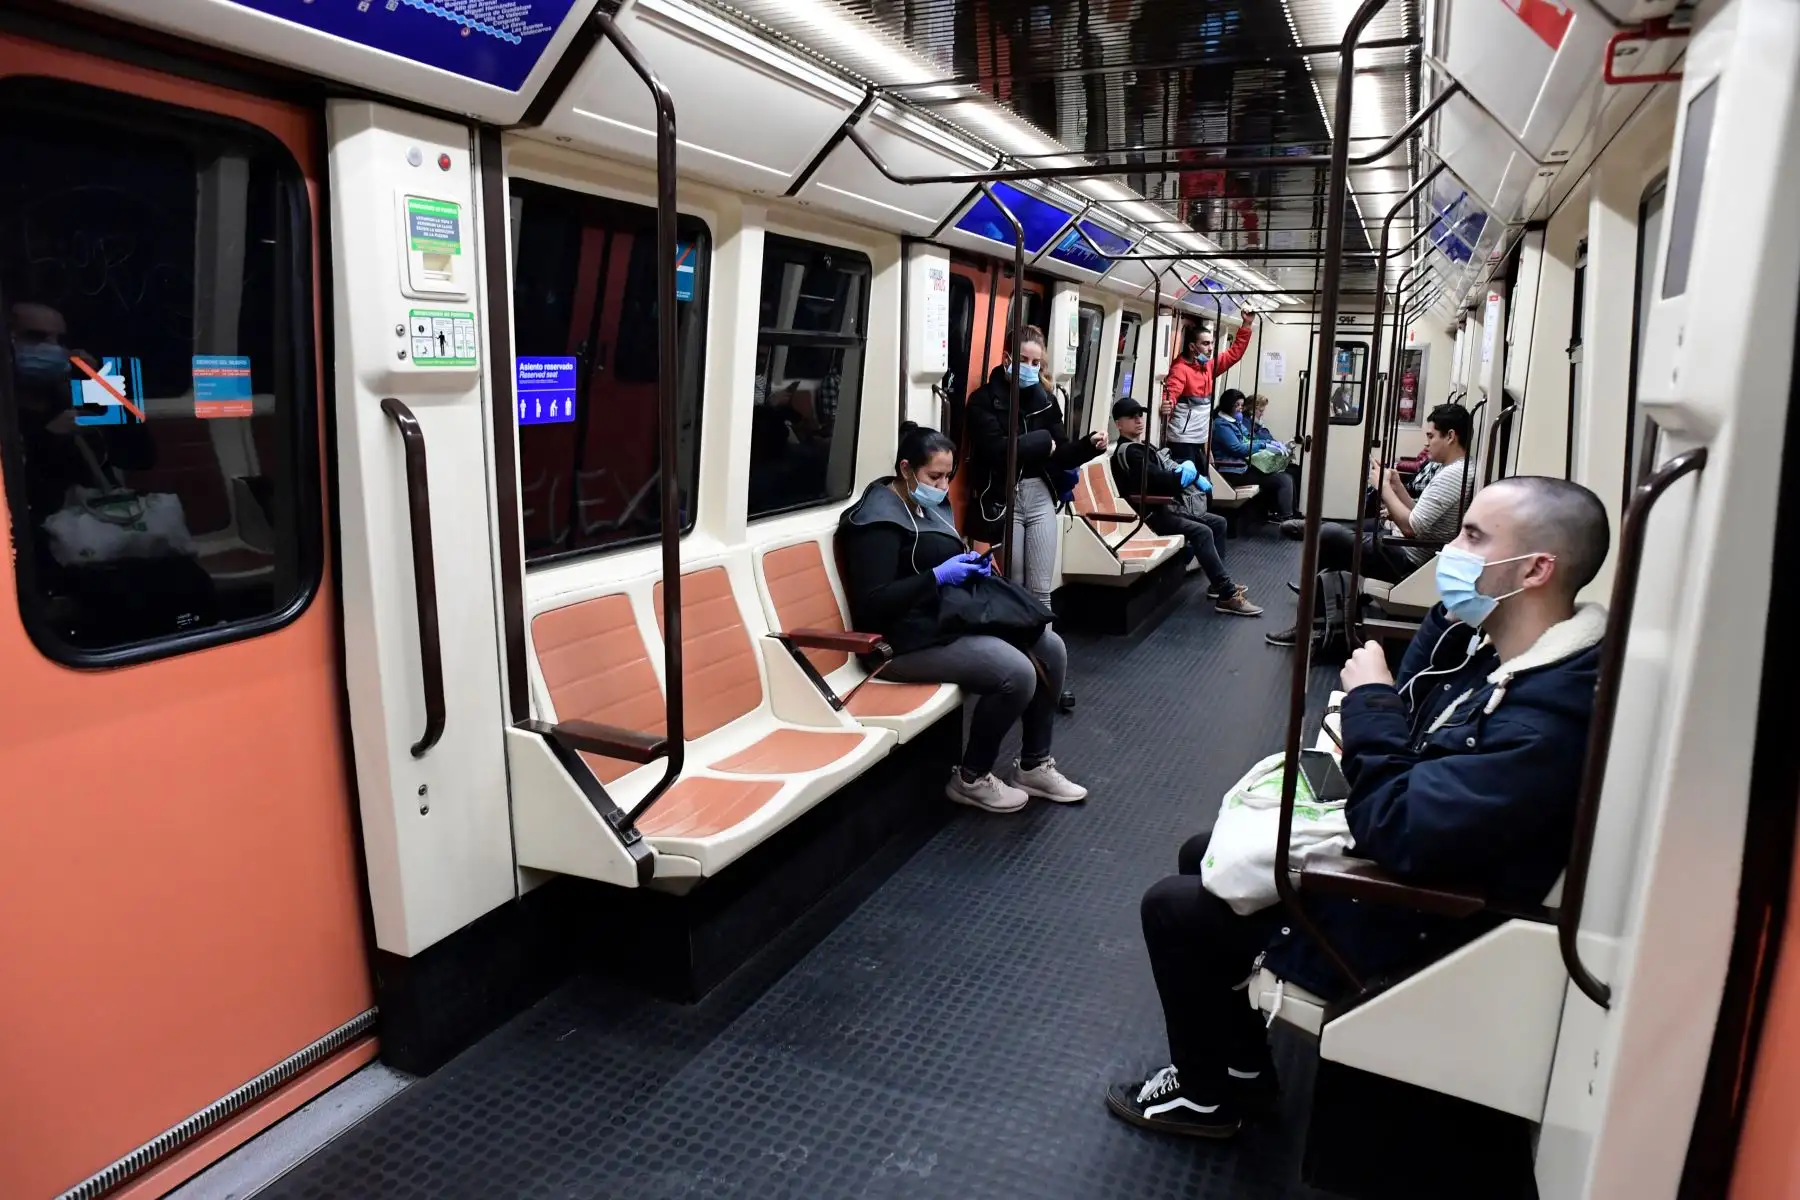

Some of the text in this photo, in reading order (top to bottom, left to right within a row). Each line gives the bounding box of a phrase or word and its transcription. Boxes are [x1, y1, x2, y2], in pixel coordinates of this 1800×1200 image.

[519, 362, 574, 371] Asiento reservado
[519, 371, 559, 379] Reserved seat
